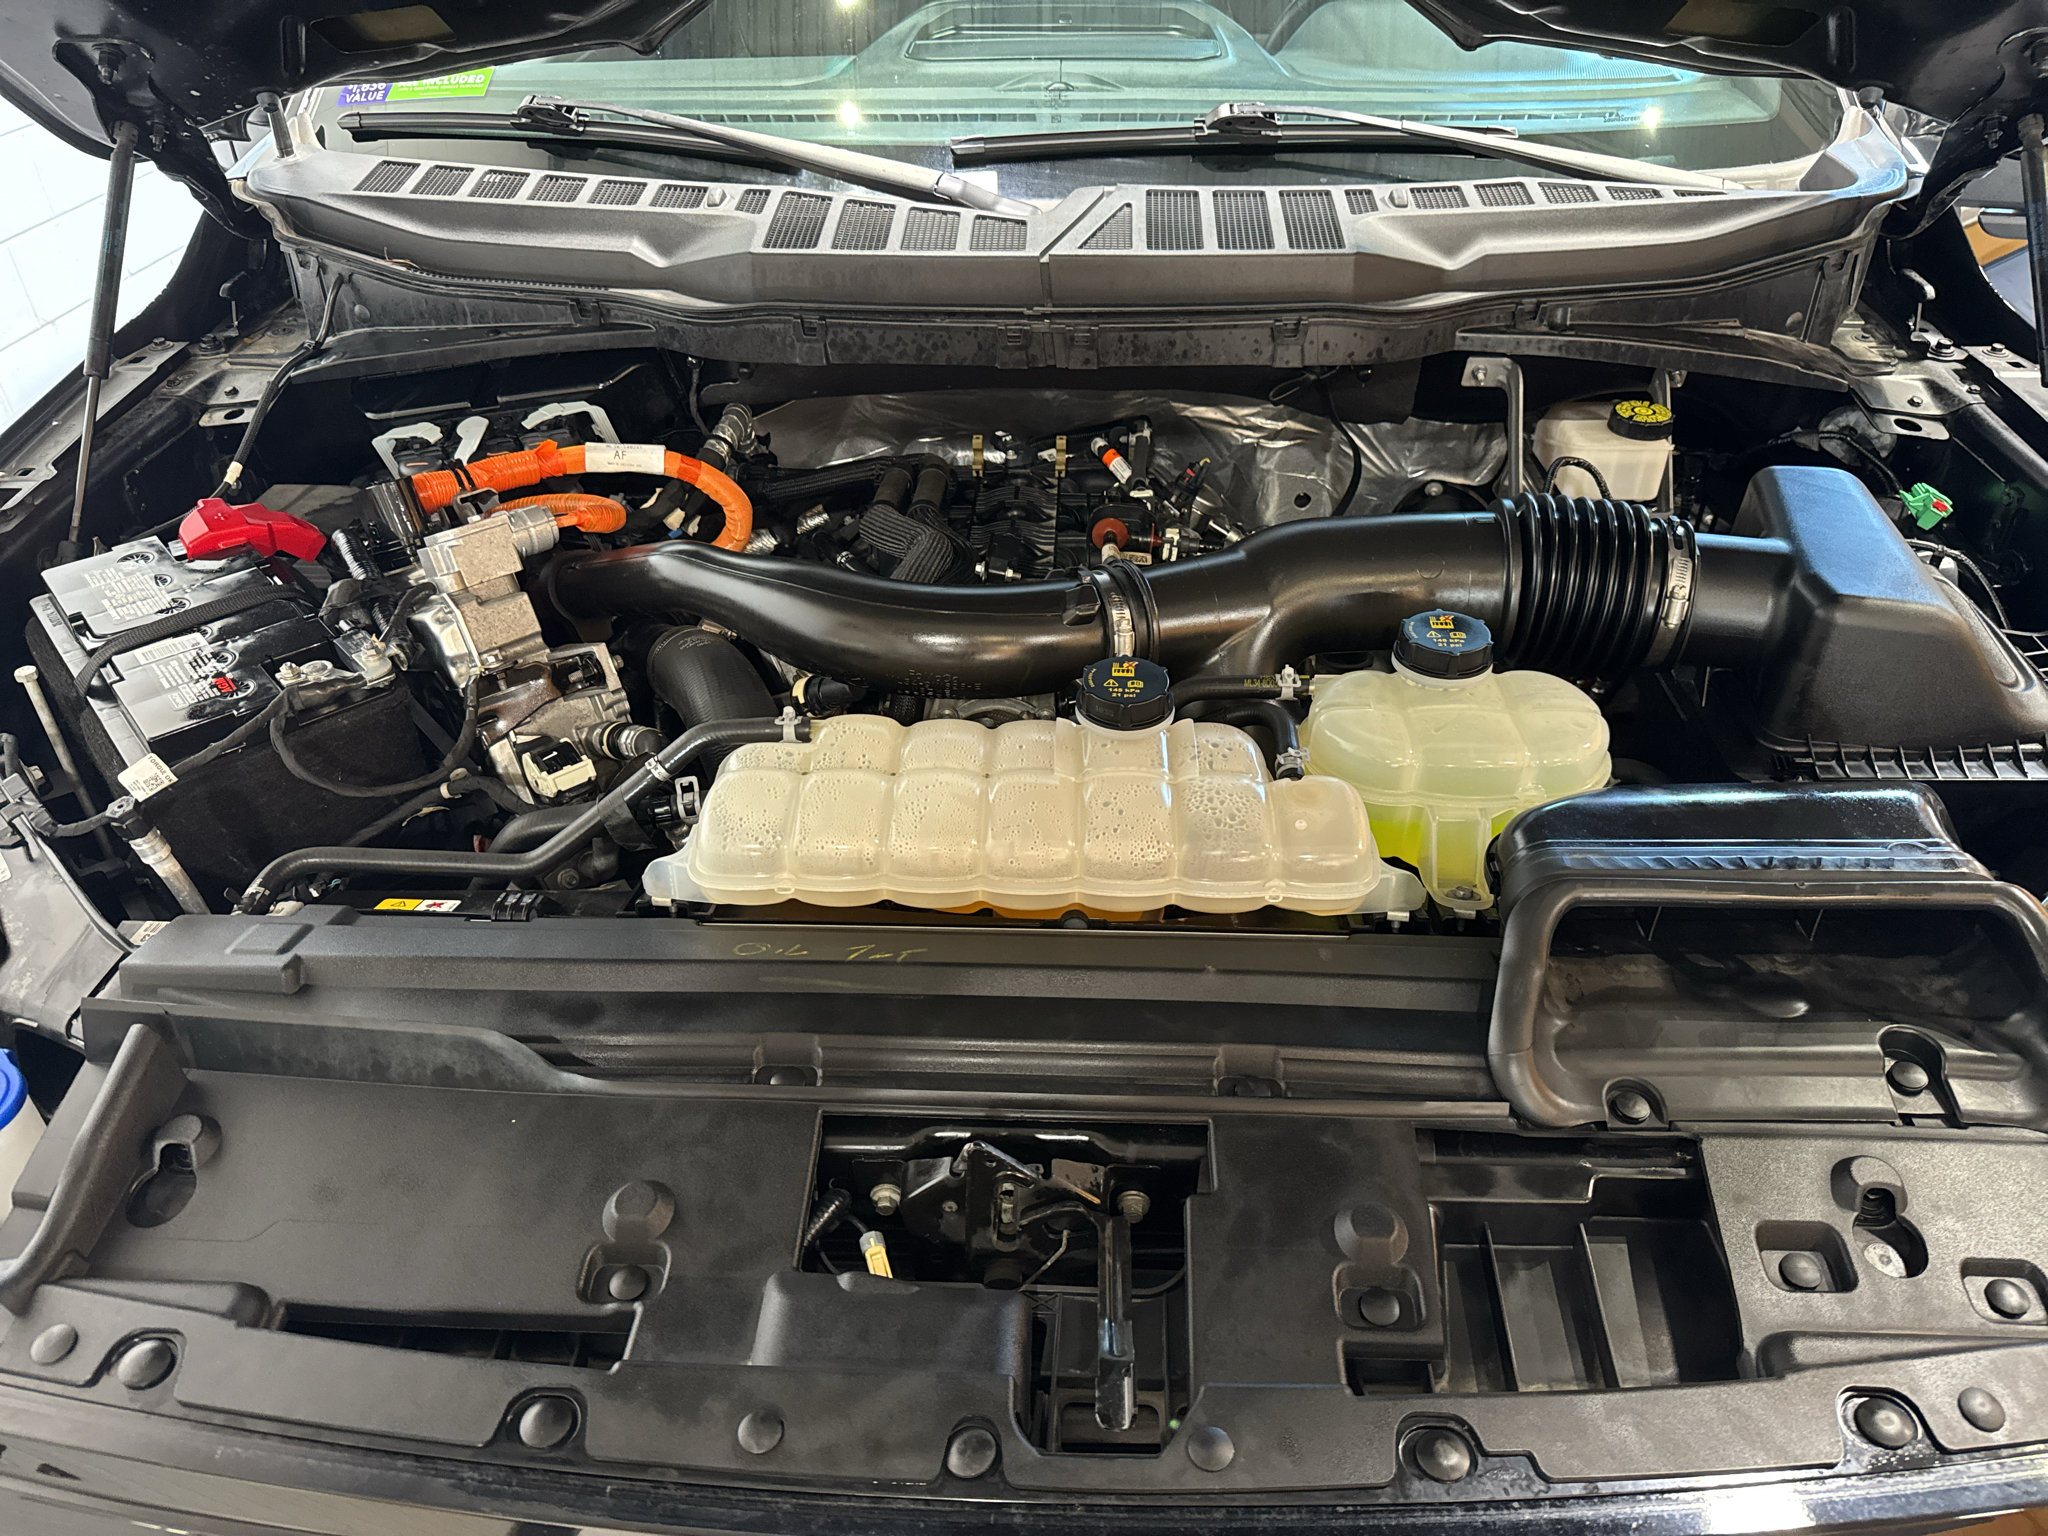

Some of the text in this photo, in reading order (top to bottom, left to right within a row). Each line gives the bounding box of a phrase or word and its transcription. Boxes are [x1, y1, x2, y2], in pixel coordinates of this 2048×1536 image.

[346, 90, 386, 103] VALUE
[613, 450, 627, 460] AF
[148, 756, 167, 776] TORQUE
